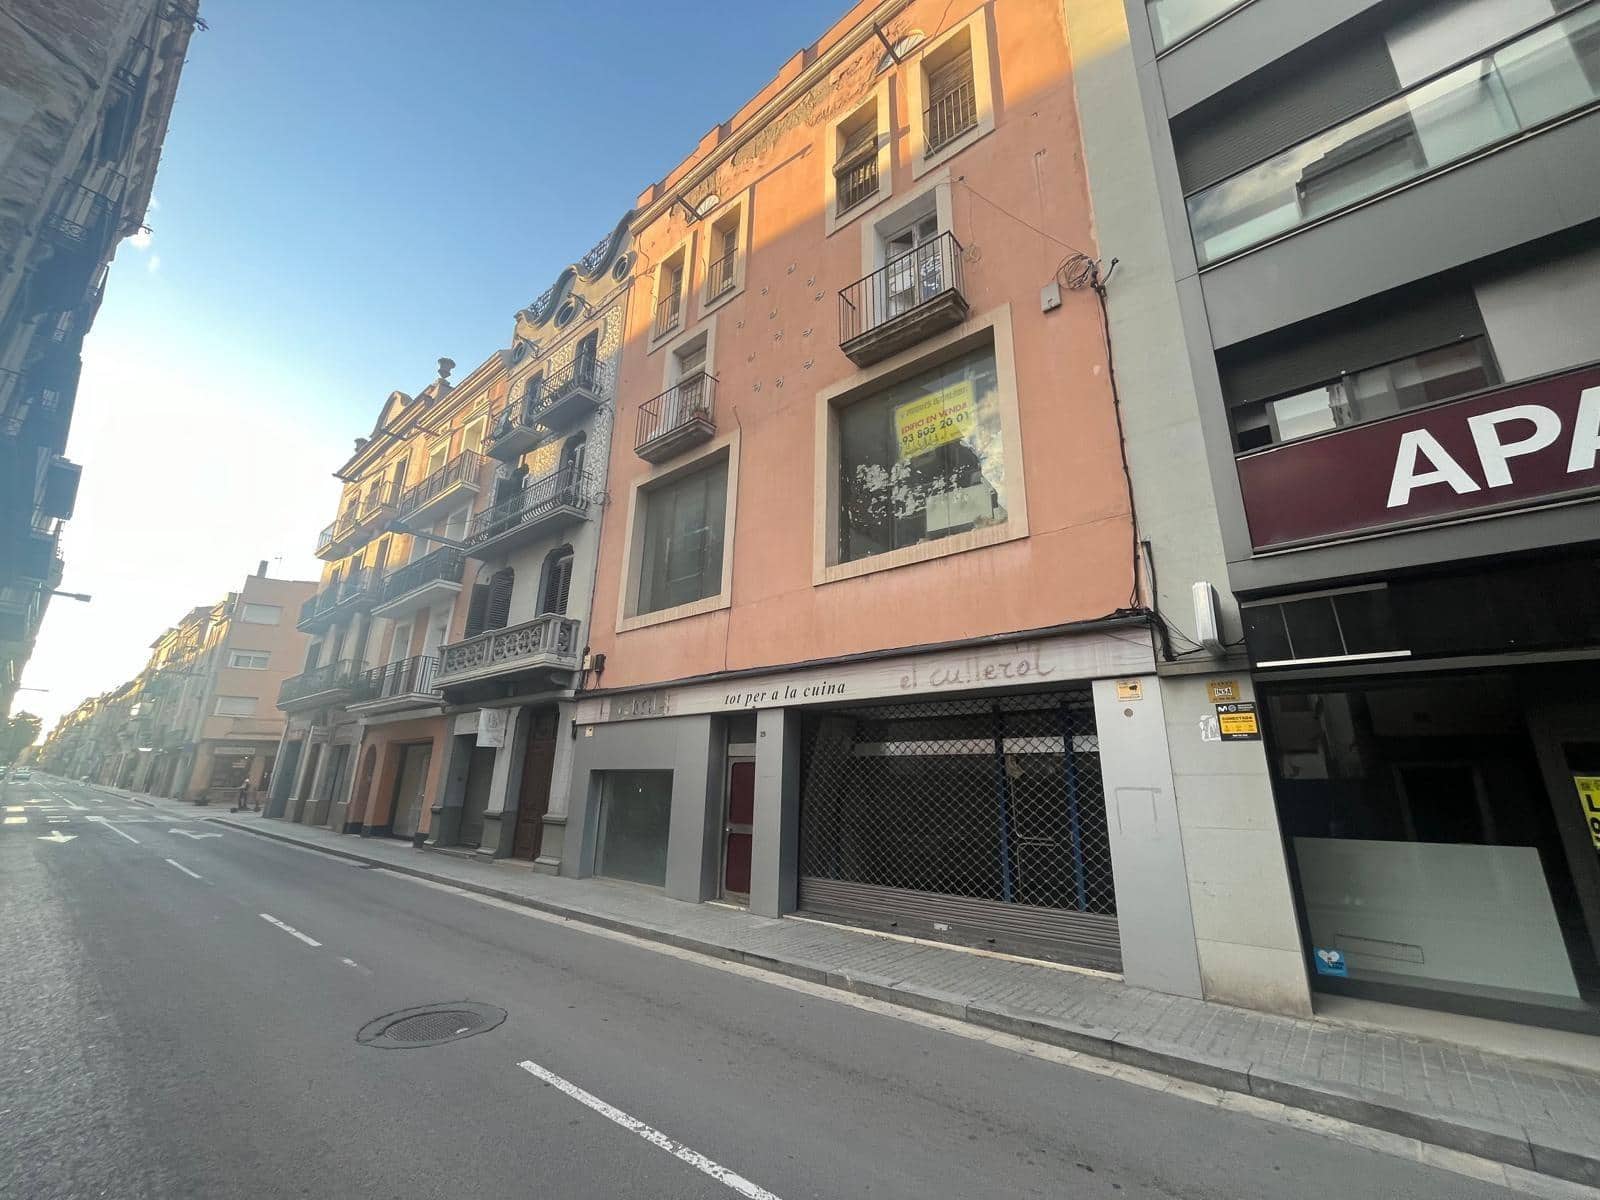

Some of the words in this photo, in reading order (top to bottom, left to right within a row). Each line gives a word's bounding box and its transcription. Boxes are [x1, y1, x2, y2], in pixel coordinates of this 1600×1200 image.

[940, 417, 953, 429] 20
[724, 693, 741, 705] tot
[744, 691, 767, 707] per
[771, 690, 779, 700] a
[784, 685, 798, 699] la
[803, 681, 845, 698] cuina
